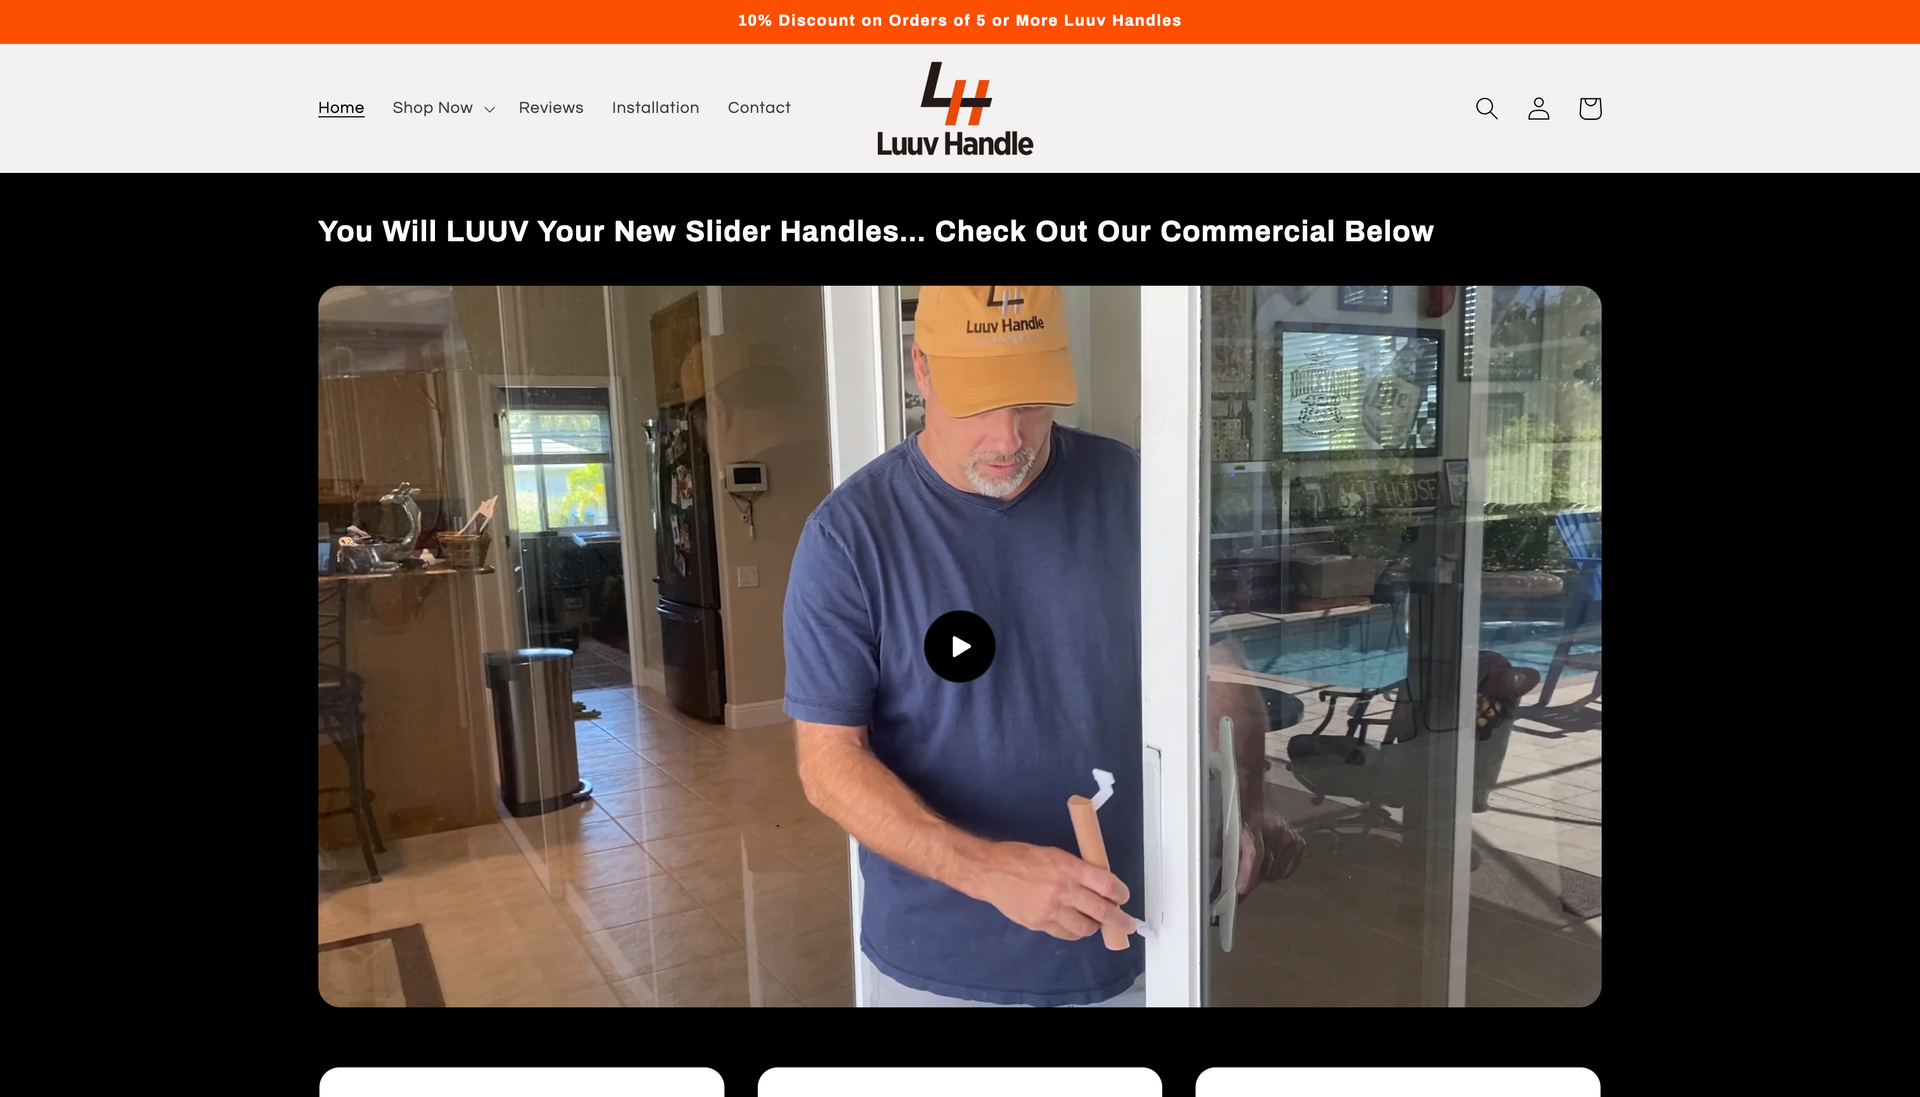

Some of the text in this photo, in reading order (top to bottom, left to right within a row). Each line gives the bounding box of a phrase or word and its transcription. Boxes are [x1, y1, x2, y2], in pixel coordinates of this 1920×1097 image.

[738, 14, 1182, 27] 10% Discount on Orders of 5 or More Luuv Handles
[318, 101, 365, 114] Home
[392, 100, 474, 117] Shop Now
[519, 101, 584, 114] Reviews
[612, 100, 700, 114] Installation
[728, 101, 792, 114] Contact
[877, 131, 1034, 156] Luuv Handle
[318, 219, 371, 243] You
[382, 219, 435, 243] Will
[447, 219, 529, 243] LUUV
[537, 219, 605, 243] Your
[615, 219, 677, 243] New
[686, 219, 772, 243] Slider
[935, 219, 1026, 243] Check
[1035, 219, 1088, 243] Out
[1097, 219, 1152, 243] Our
[1161, 219, 1335, 243] Commercial
[1345, 219, 1434, 243] Below
[966, 315, 1045, 334] Luuv Handle
